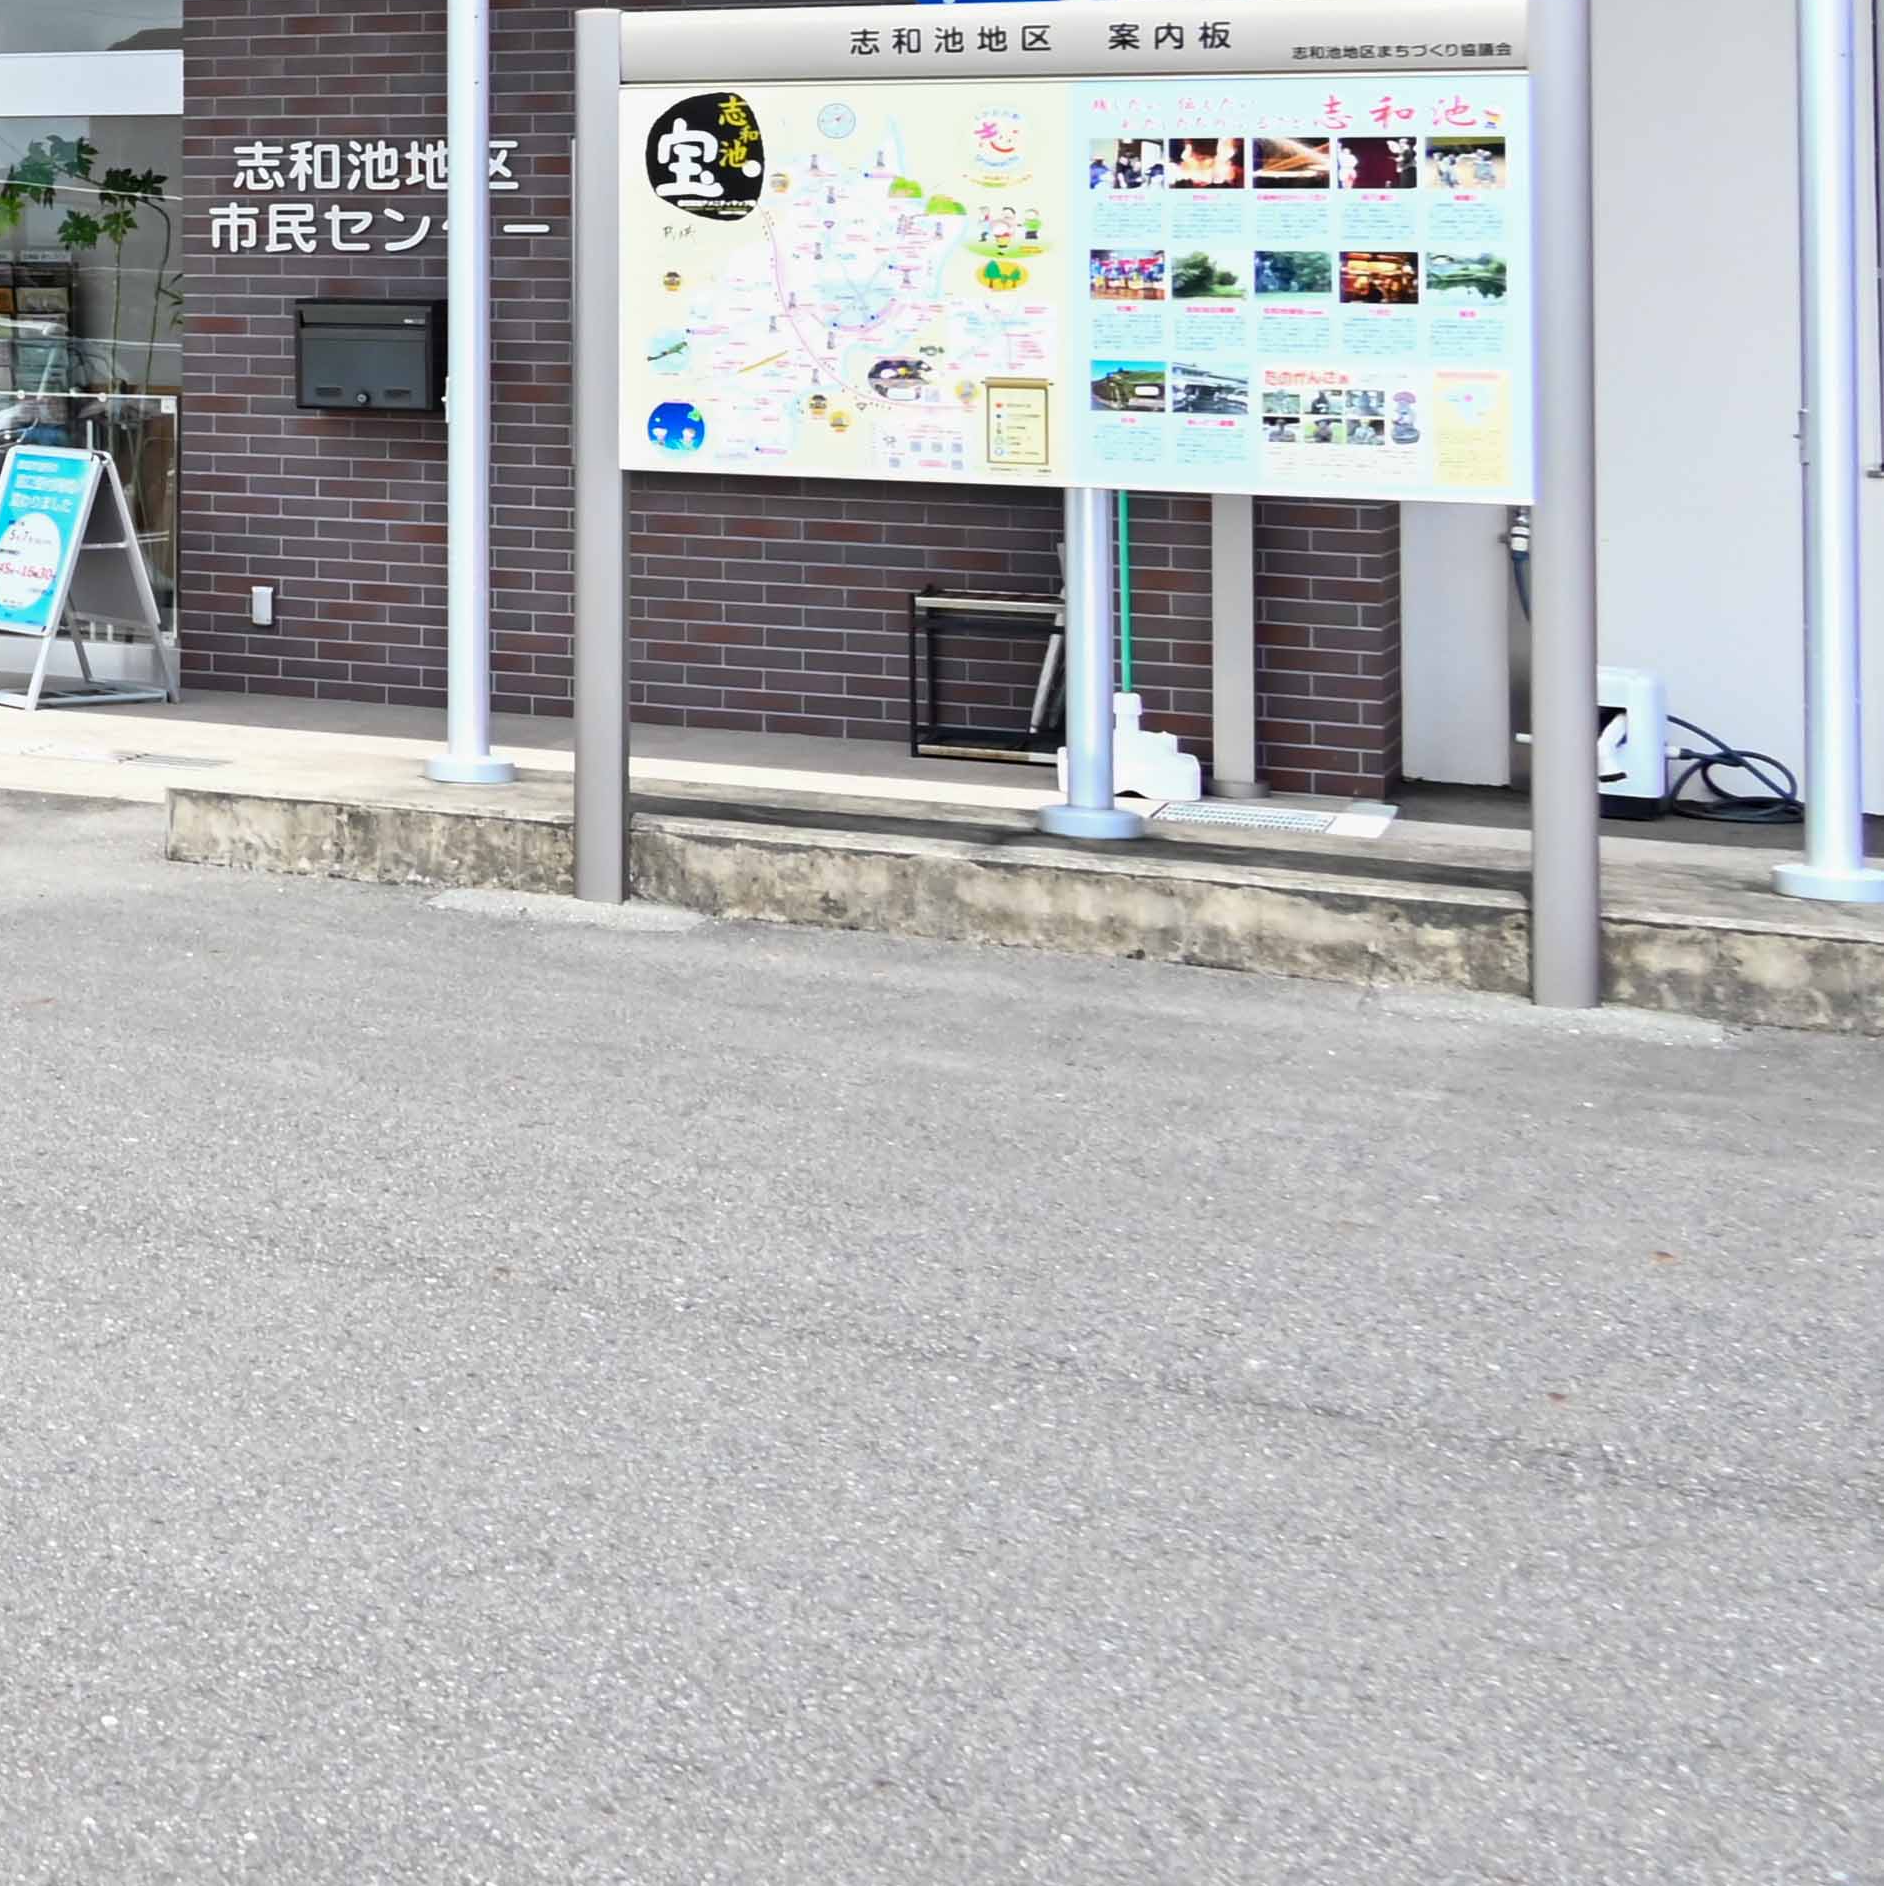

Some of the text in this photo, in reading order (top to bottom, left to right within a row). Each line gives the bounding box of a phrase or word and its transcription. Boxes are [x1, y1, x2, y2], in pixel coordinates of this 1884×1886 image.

[850, 20, 1232, 56] 志和池地区 案内板
[1291, 42, 1513, 59] 志和池地区まちづくり協議会
[718, 96, 759, 168] 志和池
[1314, 94, 1477, 131] 志和池
[233, 140, 519, 192] 志和池地区
[655, 118, 725, 197] 宝
[208, 202, 551, 253] 市民センー
